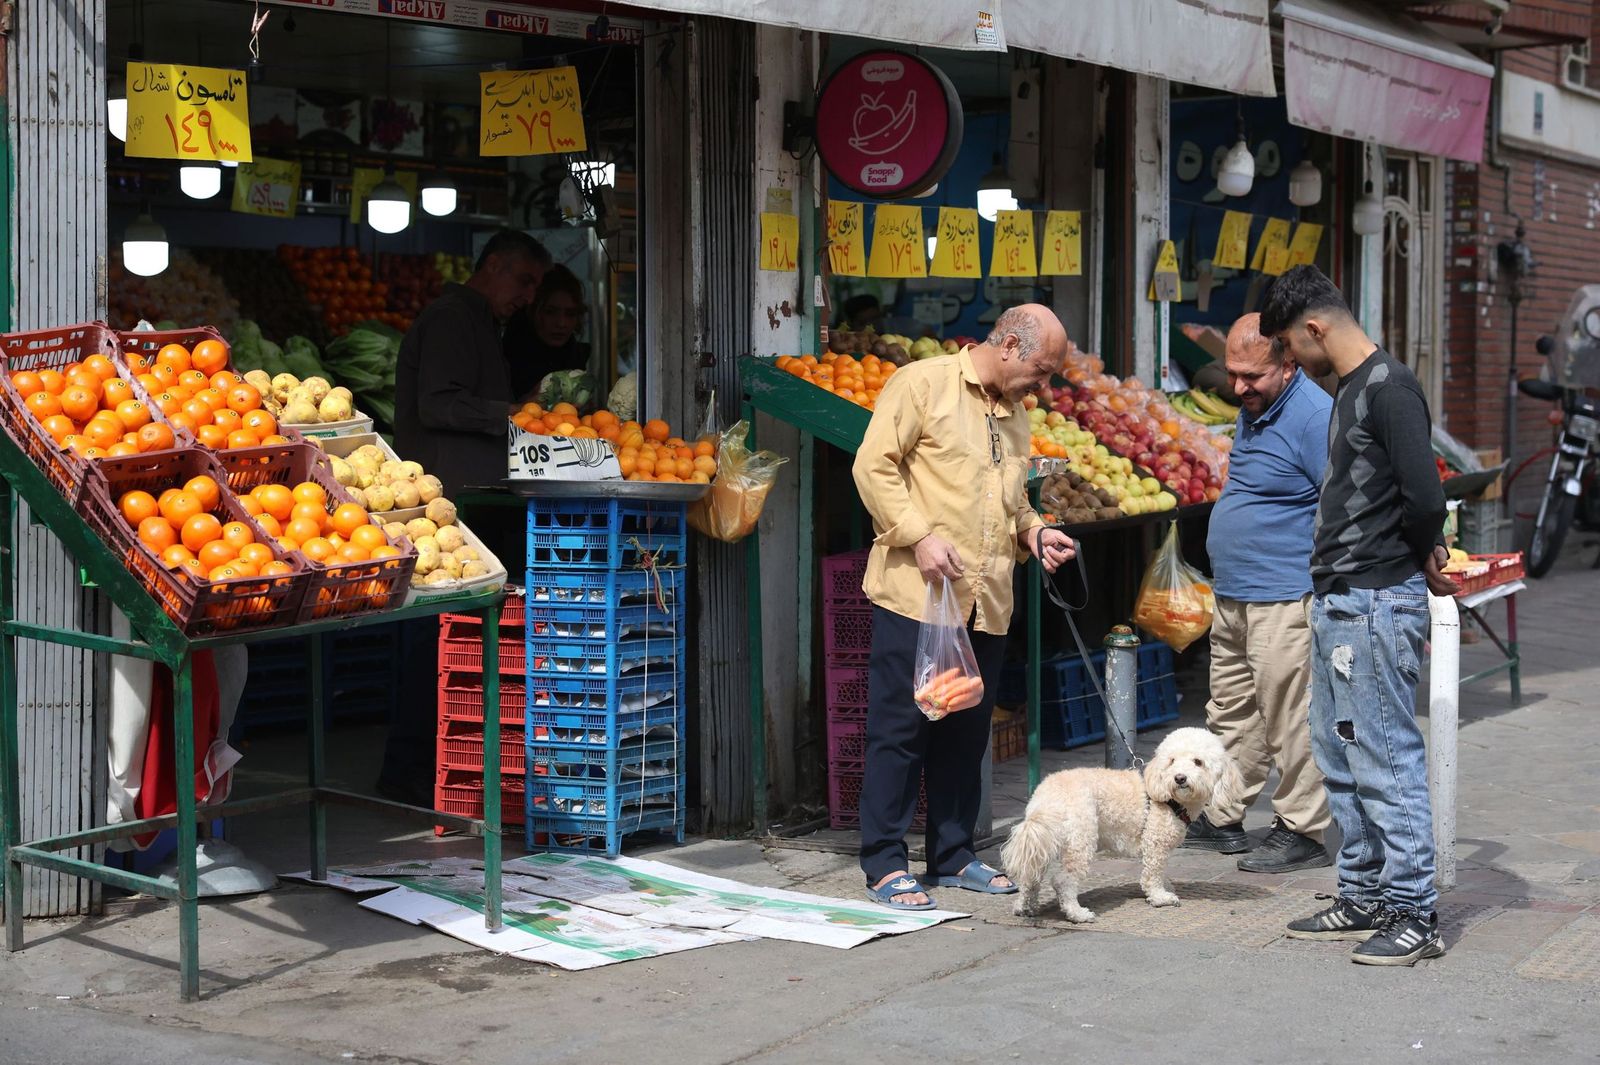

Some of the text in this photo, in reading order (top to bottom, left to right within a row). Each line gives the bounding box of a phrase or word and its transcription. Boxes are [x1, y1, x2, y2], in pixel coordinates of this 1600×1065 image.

[391, 0, 442, 19] Akpal
[497, 14, 548, 34] Akpal
[133, 66, 169, 92] شمال
[540, 73, 576, 111] پرتقال
[868, 167, 896, 176] Snapp!
[519, 443, 550, 465] SOL
